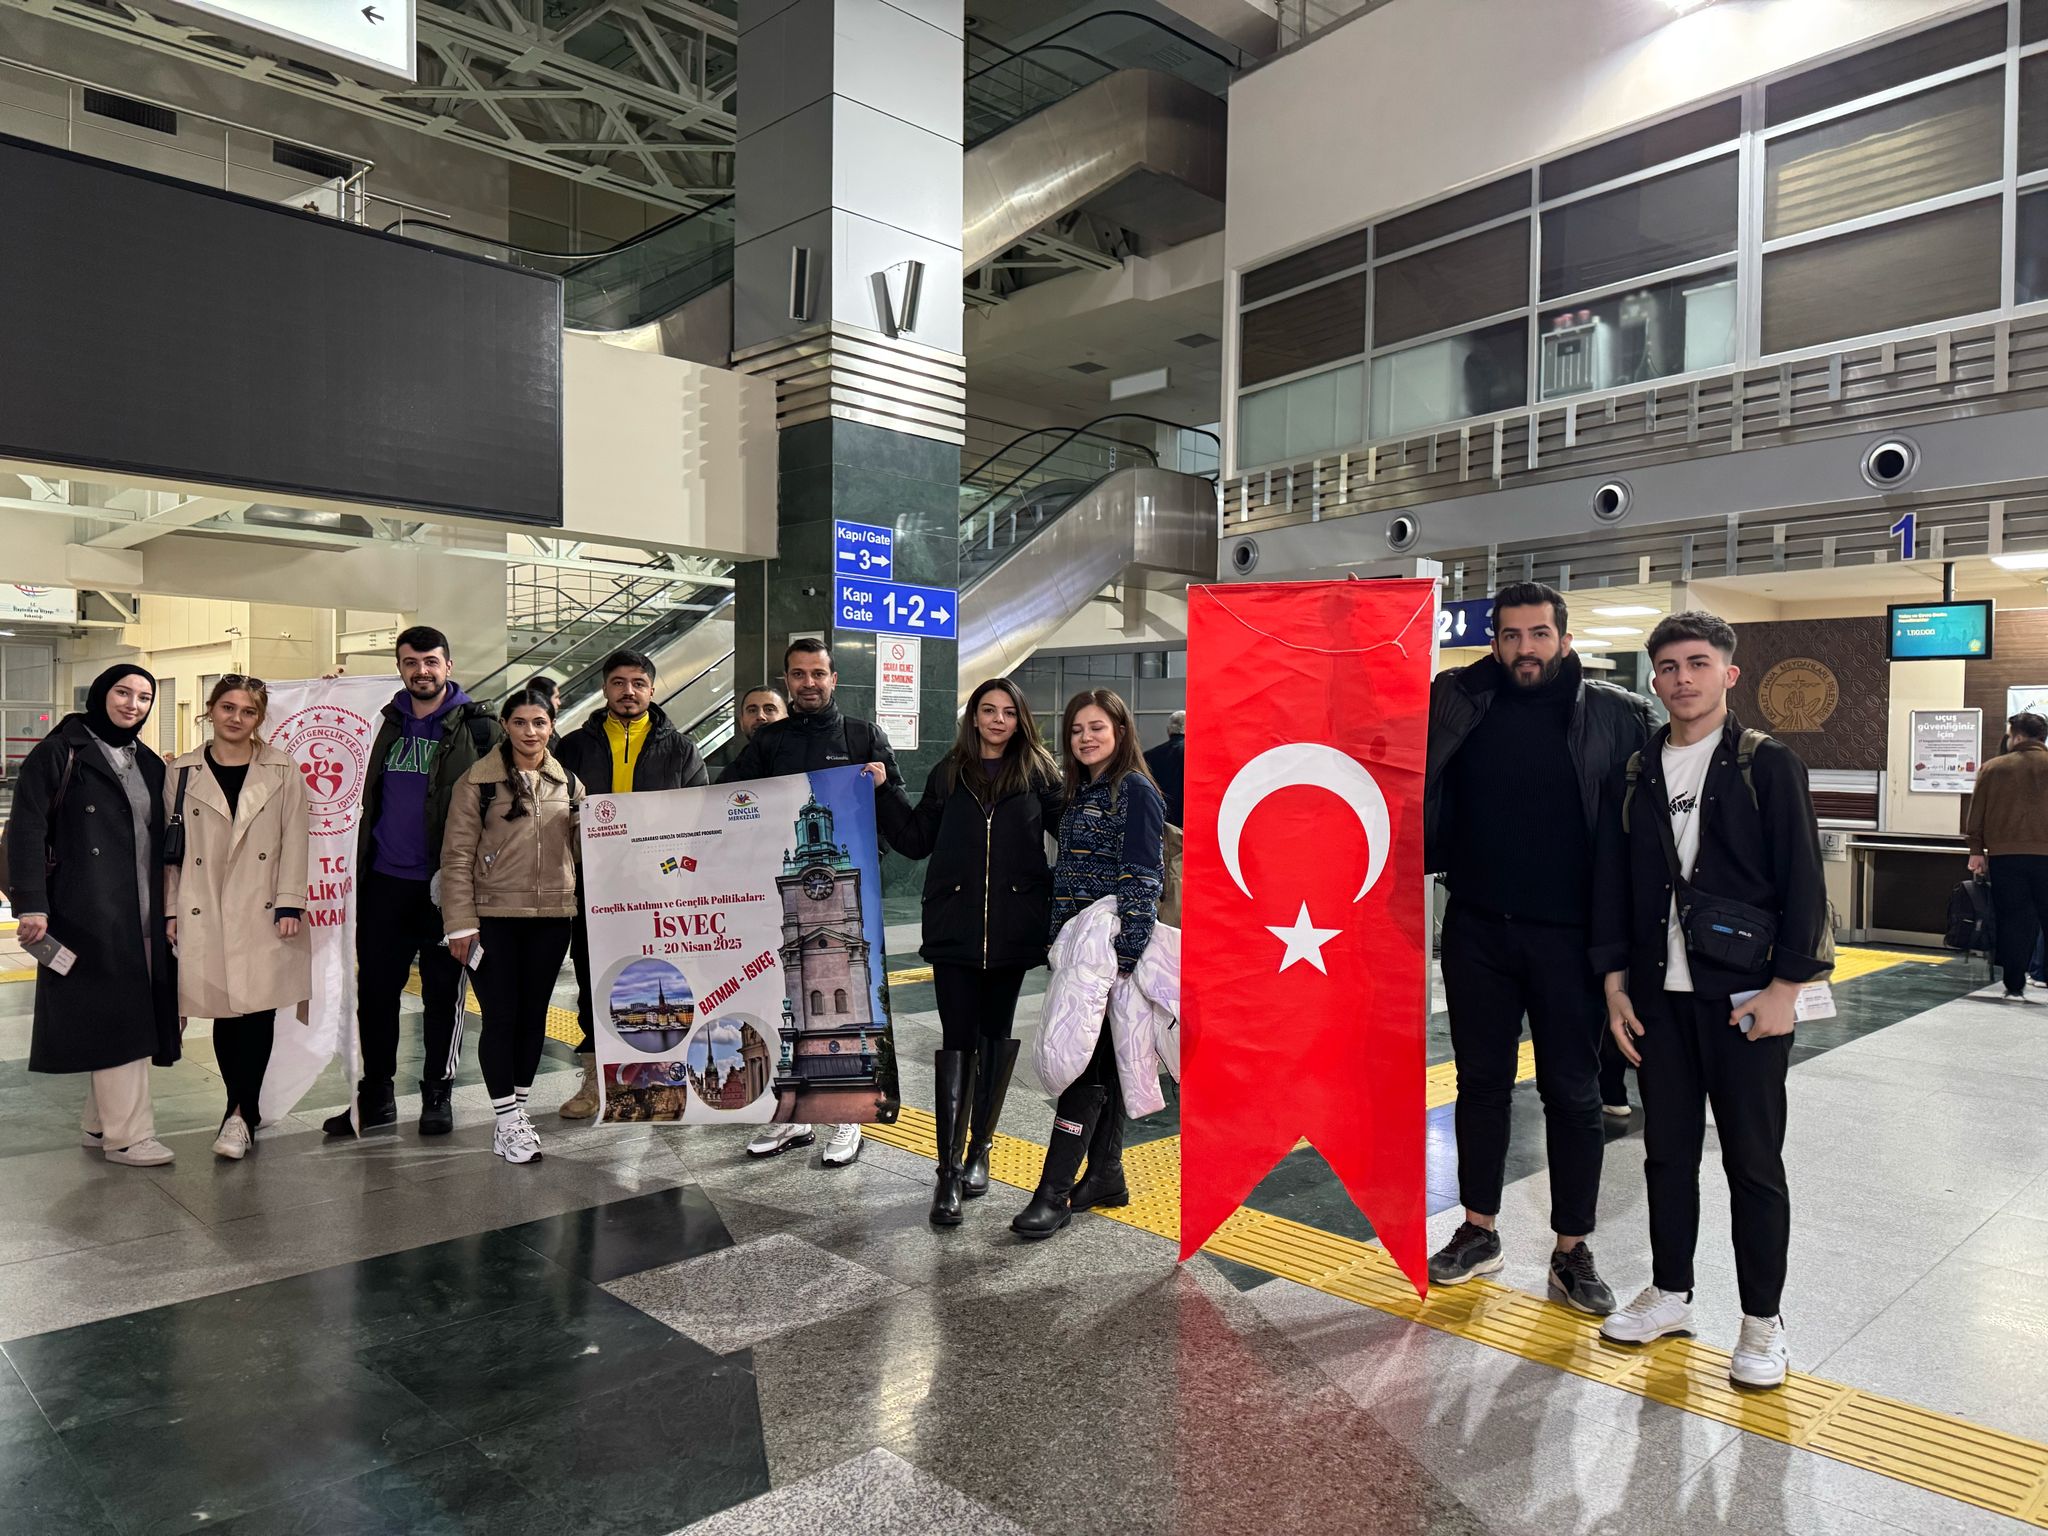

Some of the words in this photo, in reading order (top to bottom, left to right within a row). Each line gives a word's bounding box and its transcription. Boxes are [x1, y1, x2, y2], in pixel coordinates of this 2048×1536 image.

[838, 527, 891, 546] Kapı/Gate
[1889, 512, 1917, 560] 1
[843, 586, 873, 604] Kapı
[842, 605, 873, 622] Gate
[882, 592, 926, 628] 1-2
[1917, 722, 1976, 732] güvenliğiniz
[1937, 731, 1954, 739] için
[306, 729, 345, 742] GENÇLİK
[345, 738, 357, 749] VE
[319, 856, 347, 874] T.C.
[308, 879, 337, 901] LİK
[591, 903, 626, 915] Gençlik
[627, 901, 662, 911] Katılımı
[675, 896, 709, 908] Gençlik
[711, 893, 765, 904] Politikaları:
[653, 911, 726, 940] İSVEÇ
[642, 945, 654, 955] 14
[664, 942, 679, 954] 20
[680, 940, 712, 952] Nisan
[714, 938, 742, 950] 2025
[698, 976, 741, 1016] BATMAN
[741, 950, 776, 981] İSVEÇ
